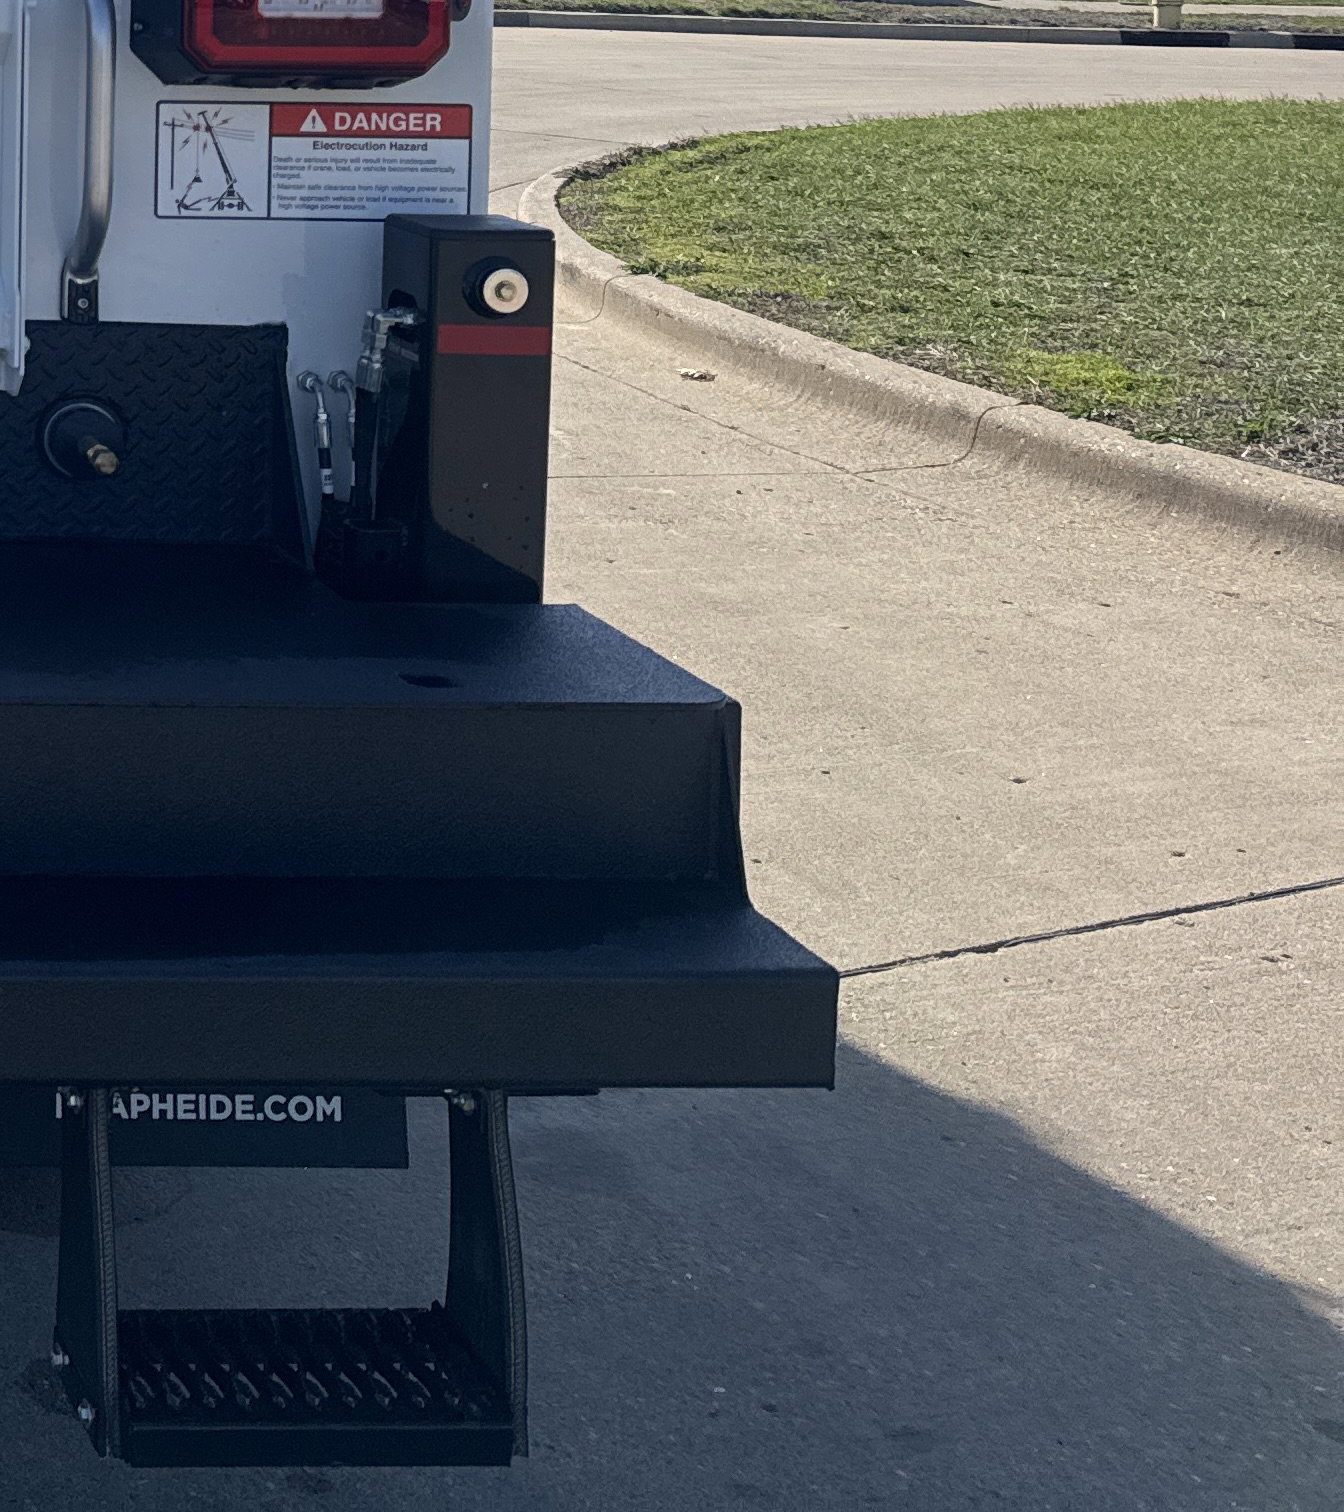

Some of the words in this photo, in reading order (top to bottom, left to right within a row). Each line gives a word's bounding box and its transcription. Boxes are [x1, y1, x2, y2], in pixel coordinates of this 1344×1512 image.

[333, 112, 442, 132] DANGER
[312, 140, 387, 151] Electrocution
[389, 141, 428, 152] Hazard
[55, 1093, 343, 1122] APHEIDE.COM
